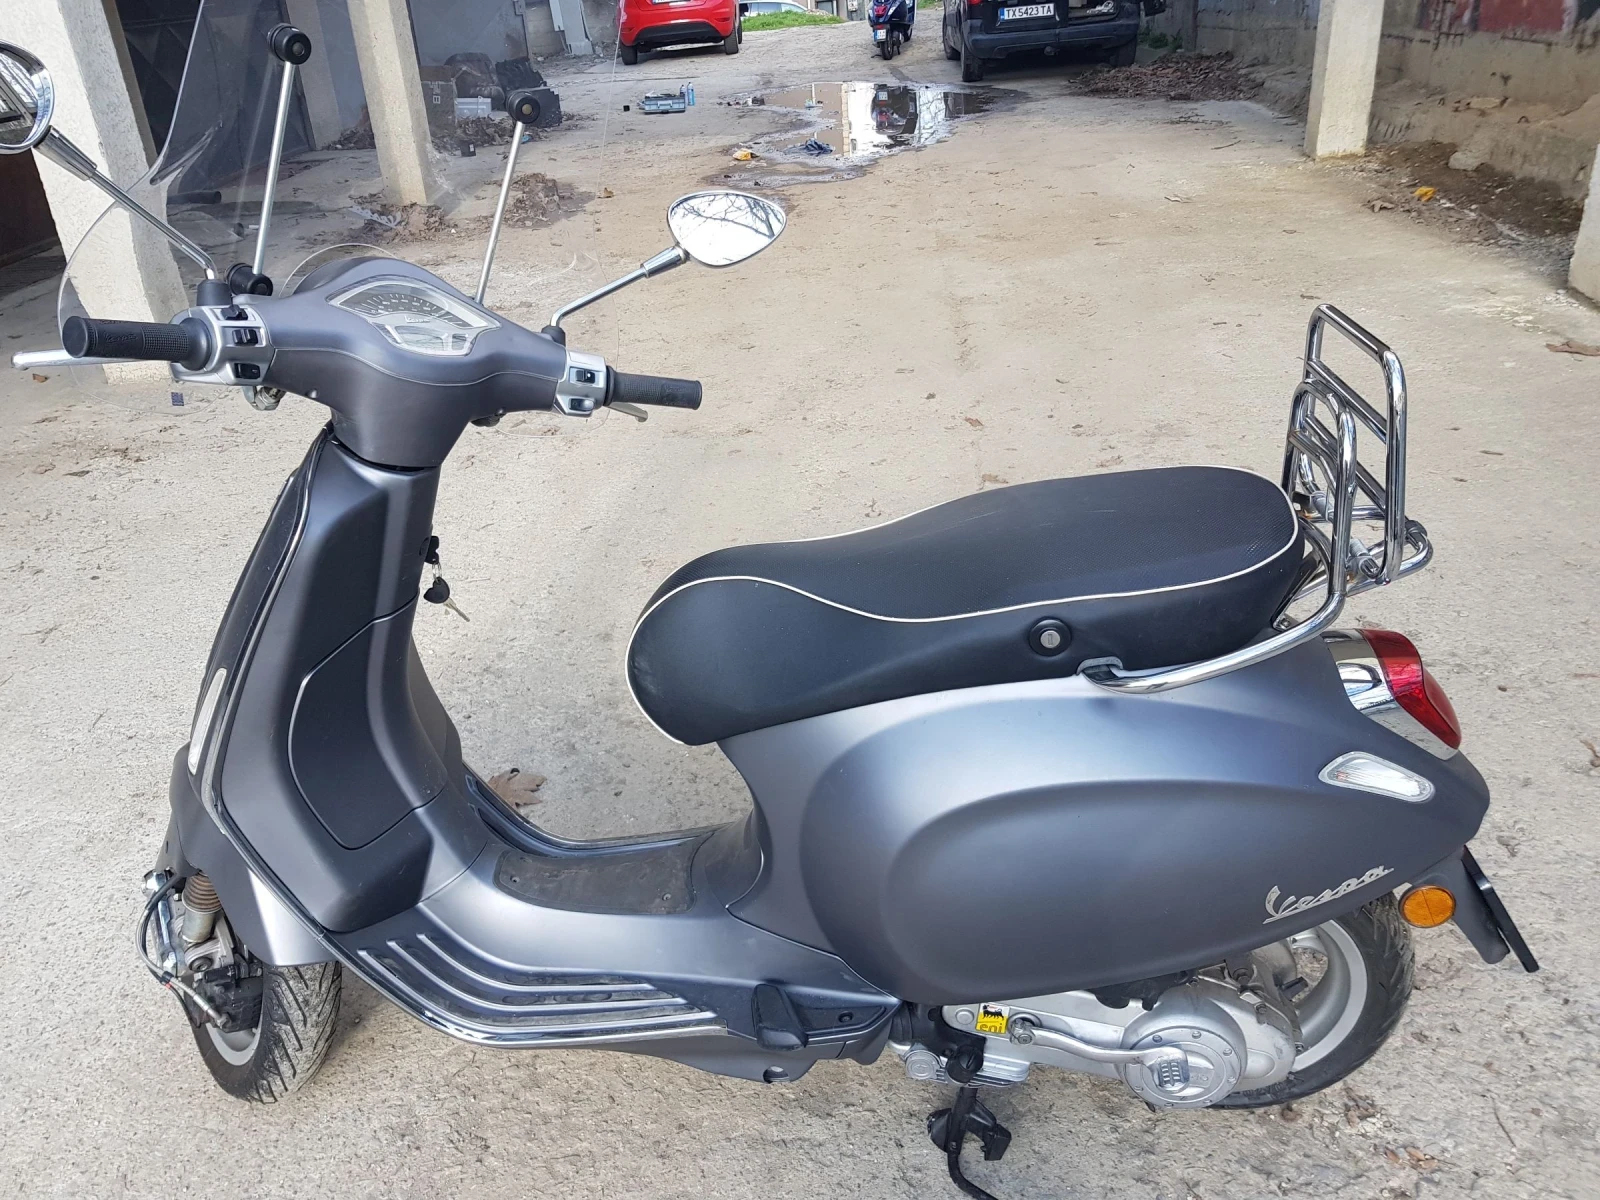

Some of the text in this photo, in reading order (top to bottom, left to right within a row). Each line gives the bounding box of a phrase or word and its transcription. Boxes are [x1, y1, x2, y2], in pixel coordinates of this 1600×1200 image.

[1006, 5, 1052, 17] TX 5423 TA
[1262, 865, 1394, 924] Vespa
[979, 1023, 1003, 1033] eni
